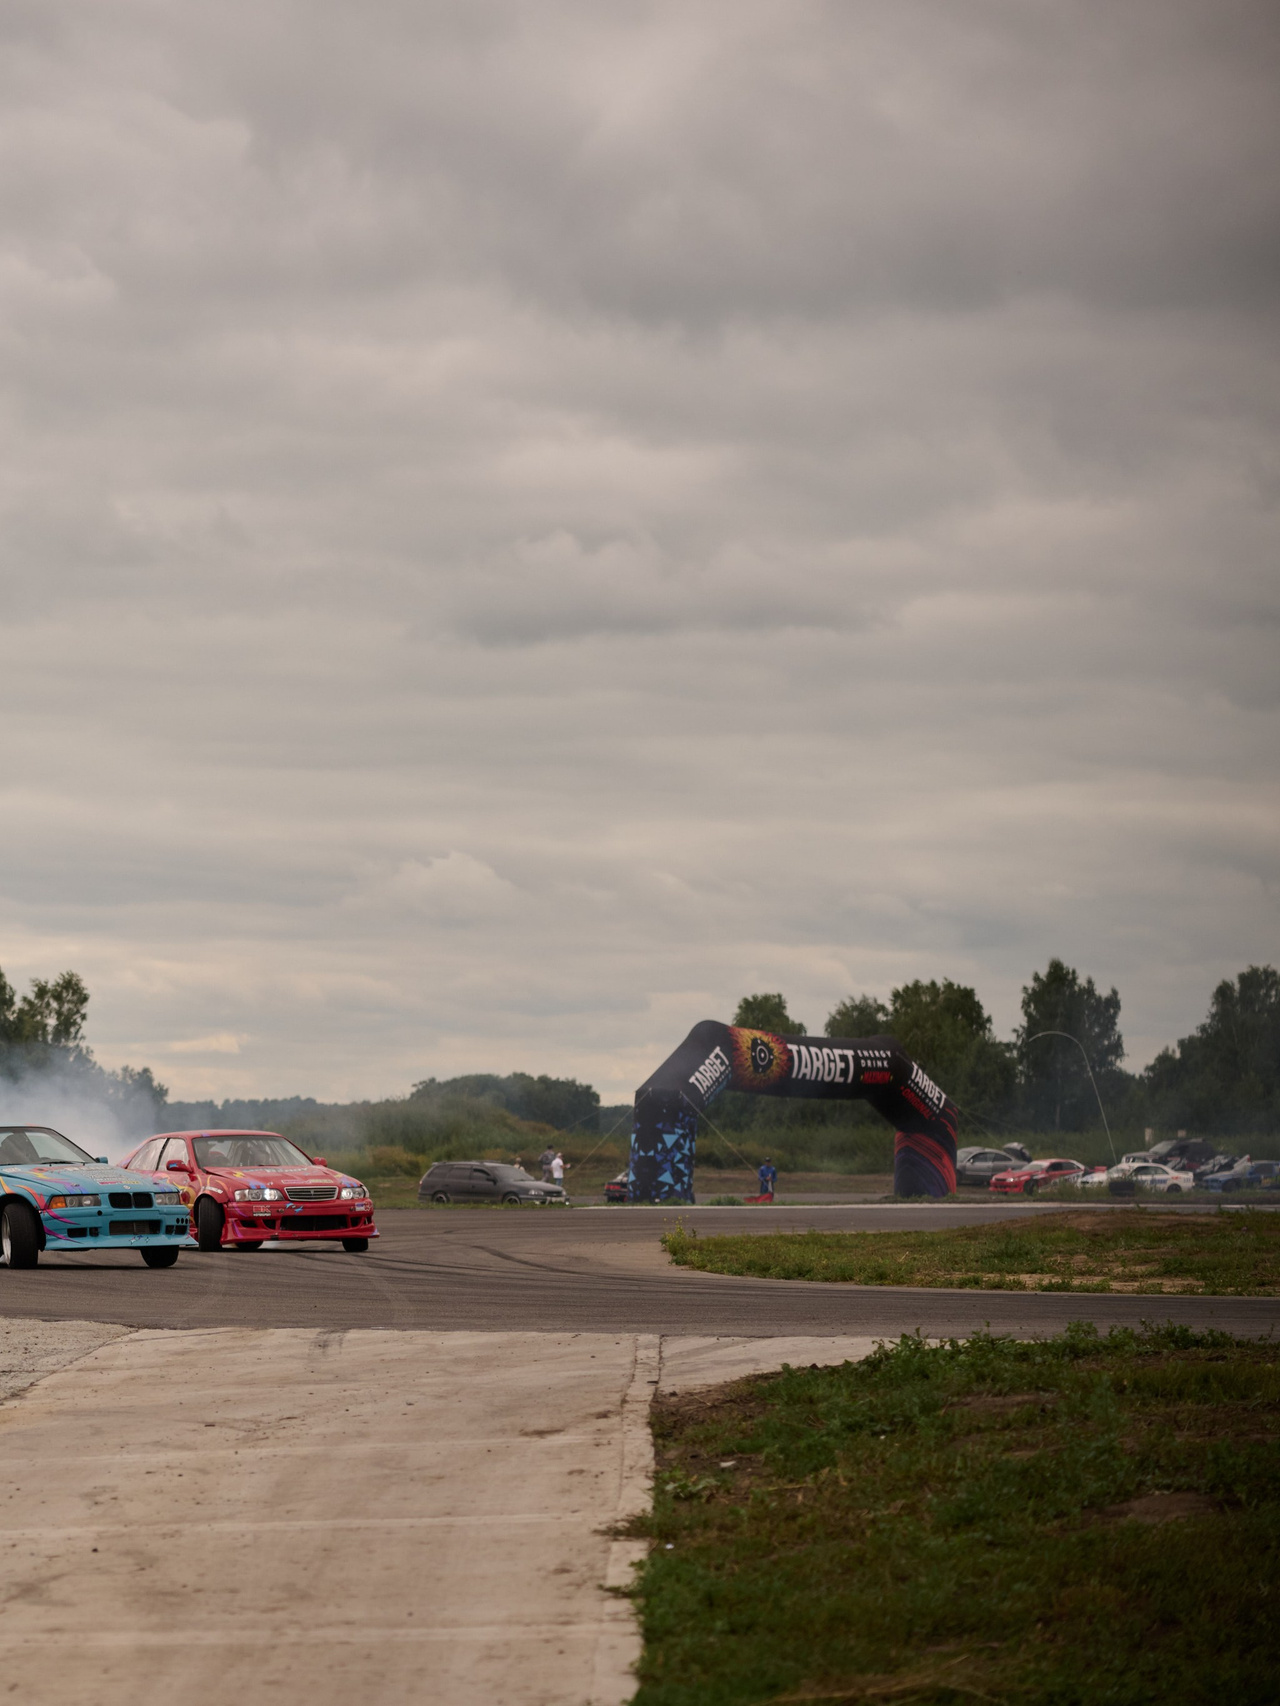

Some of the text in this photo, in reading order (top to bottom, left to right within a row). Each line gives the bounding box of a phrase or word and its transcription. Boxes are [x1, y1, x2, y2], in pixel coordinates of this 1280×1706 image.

[689, 1046, 729, 1094] TARGET
[786, 1043, 855, 1083] TARGET
[857, 1049, 891, 1058] ENERGY
[861, 1059, 889, 1068] DRINK
[911, 1061, 946, 1109] TARGET
